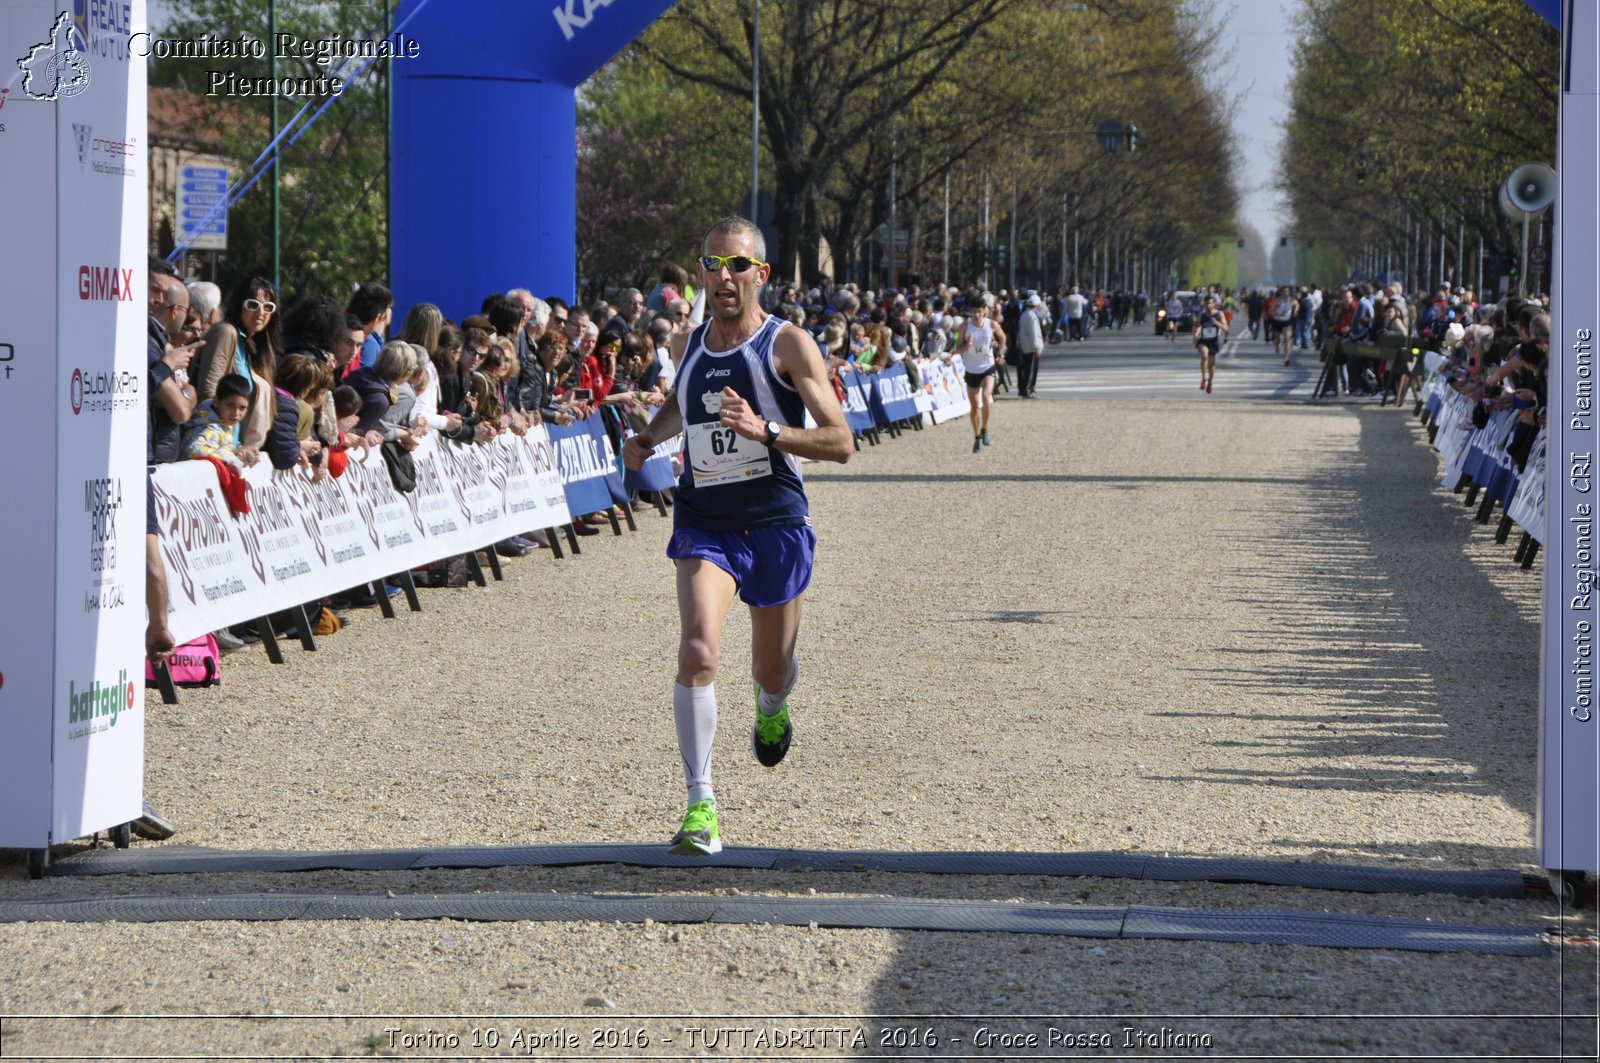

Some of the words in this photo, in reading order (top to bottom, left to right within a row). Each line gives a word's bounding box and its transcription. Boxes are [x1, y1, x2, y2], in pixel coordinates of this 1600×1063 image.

[90, 0, 131, 35] REALE
[79, 265, 133, 301] GIMAX
[83, 371, 139, 395] SubMixPro
[714, 368, 732, 377] asics
[83, 398, 139, 414] management
[711, 428, 739, 456] 62
[85, 478, 122, 513] MISCELA
[92, 508, 116, 543] ROCK
[69, 668, 135, 727] battaglio
